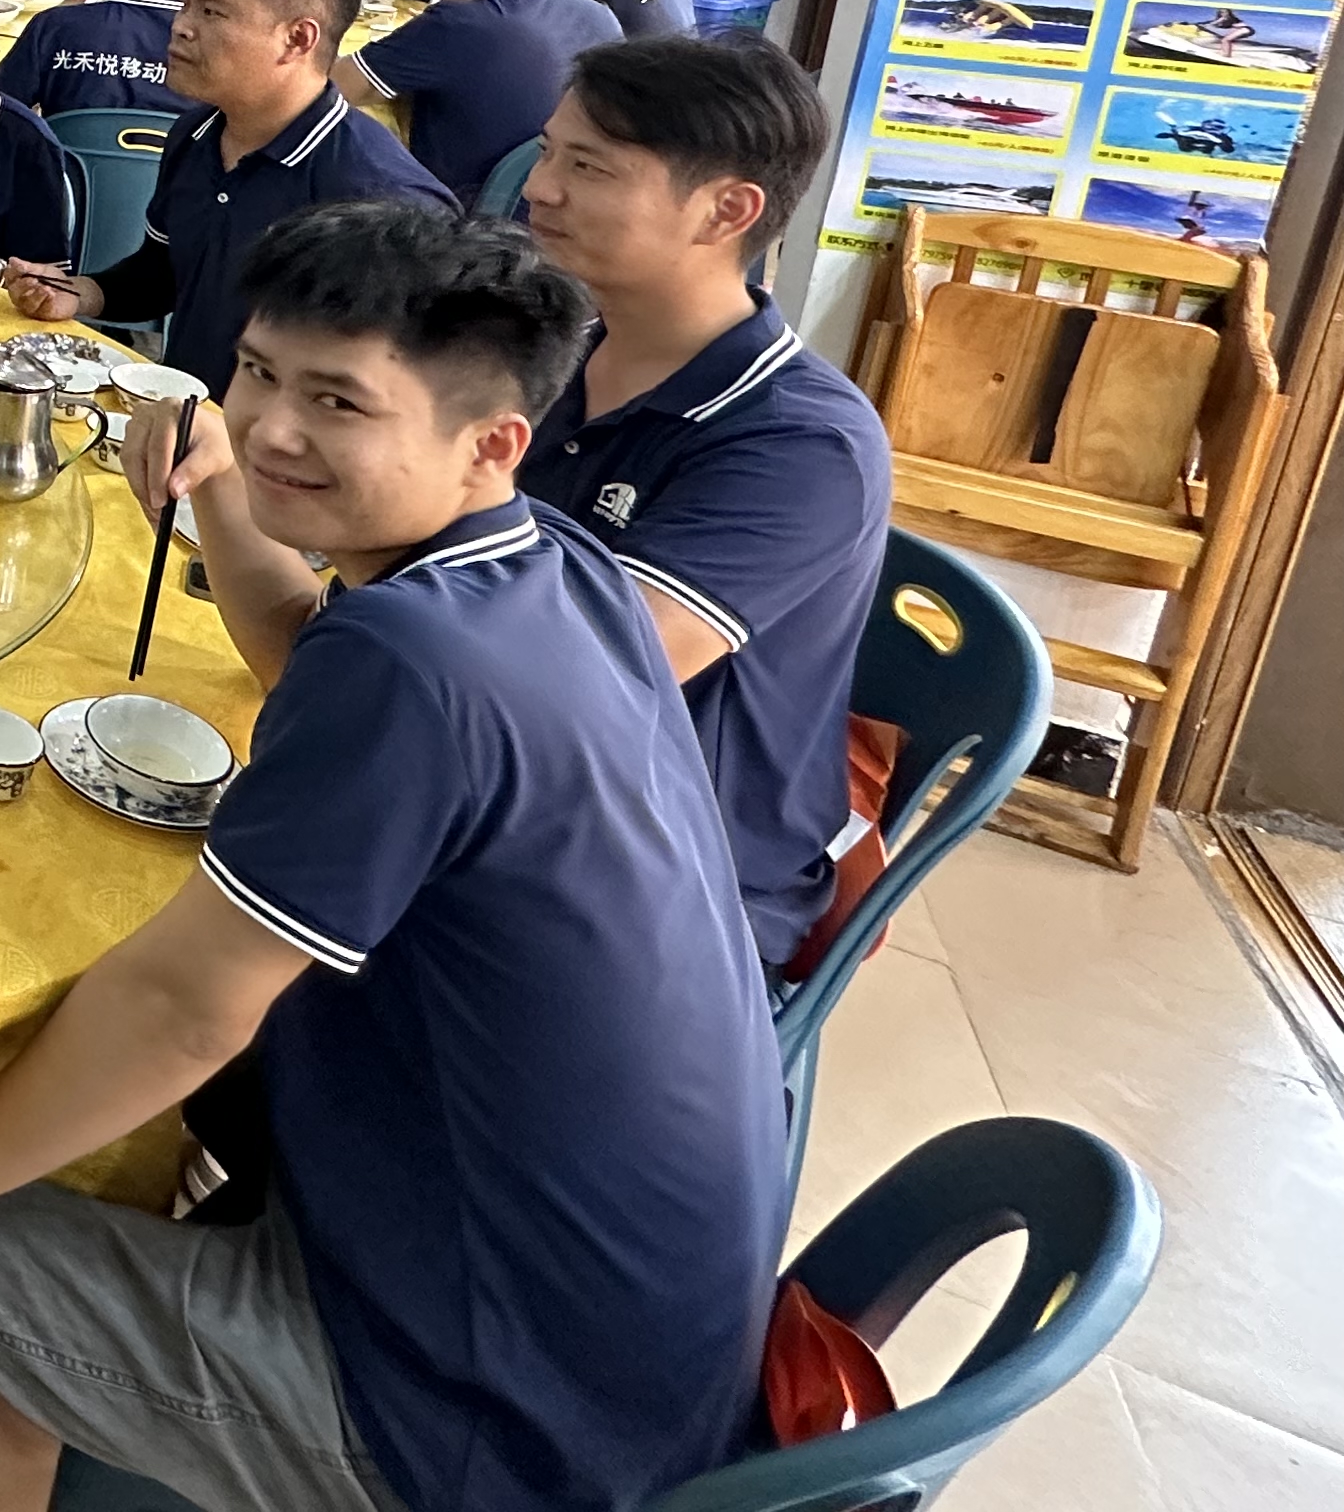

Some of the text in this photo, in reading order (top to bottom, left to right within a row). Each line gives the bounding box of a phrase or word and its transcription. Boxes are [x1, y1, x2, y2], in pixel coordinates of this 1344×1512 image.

[53, 48, 167, 84] 光禾悦移动
